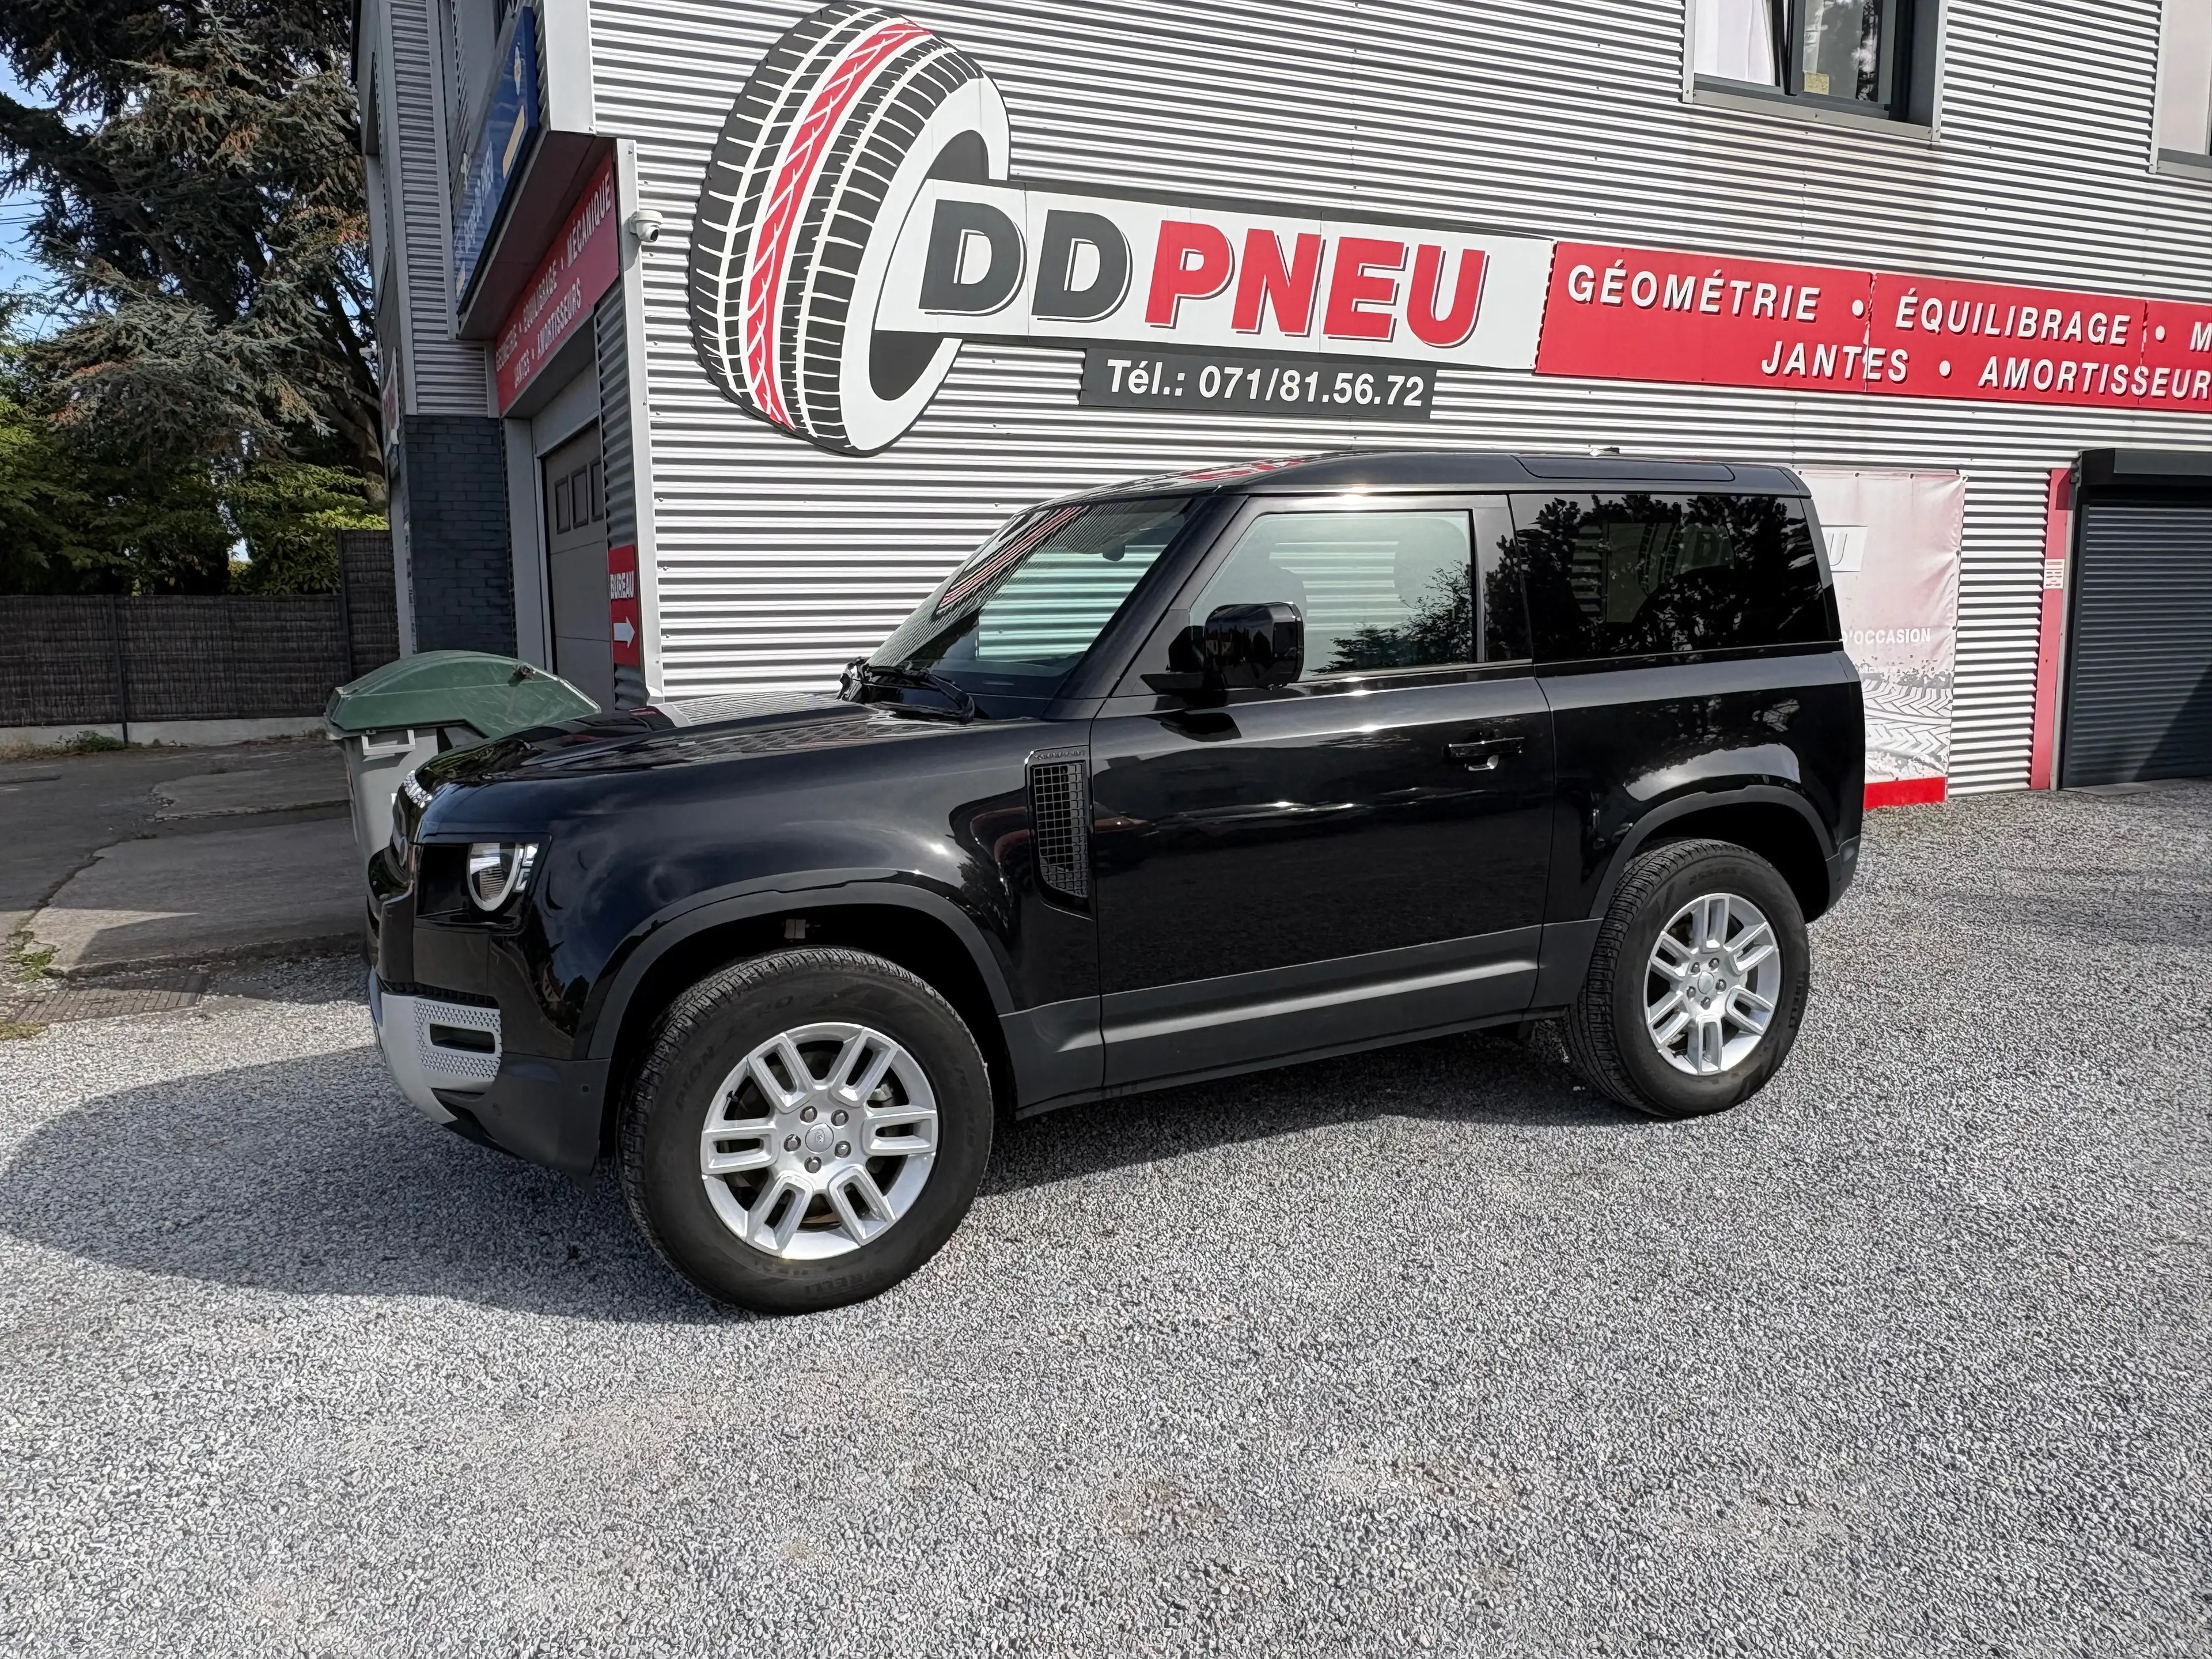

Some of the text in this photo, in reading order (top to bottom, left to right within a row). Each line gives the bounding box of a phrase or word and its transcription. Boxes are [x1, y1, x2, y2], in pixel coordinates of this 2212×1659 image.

[567, 171, 612, 267] MÉCANIQUE
[1567, 259, 1821, 321] GÉOMÉTRIE
[1895, 287, 2131, 345] ÉQUILIBRAGE
[1107, 359, 1425, 407] Tél.: 071/81.56.72
[1761, 340, 2211, 399] JANTES AMORTISSEUR
